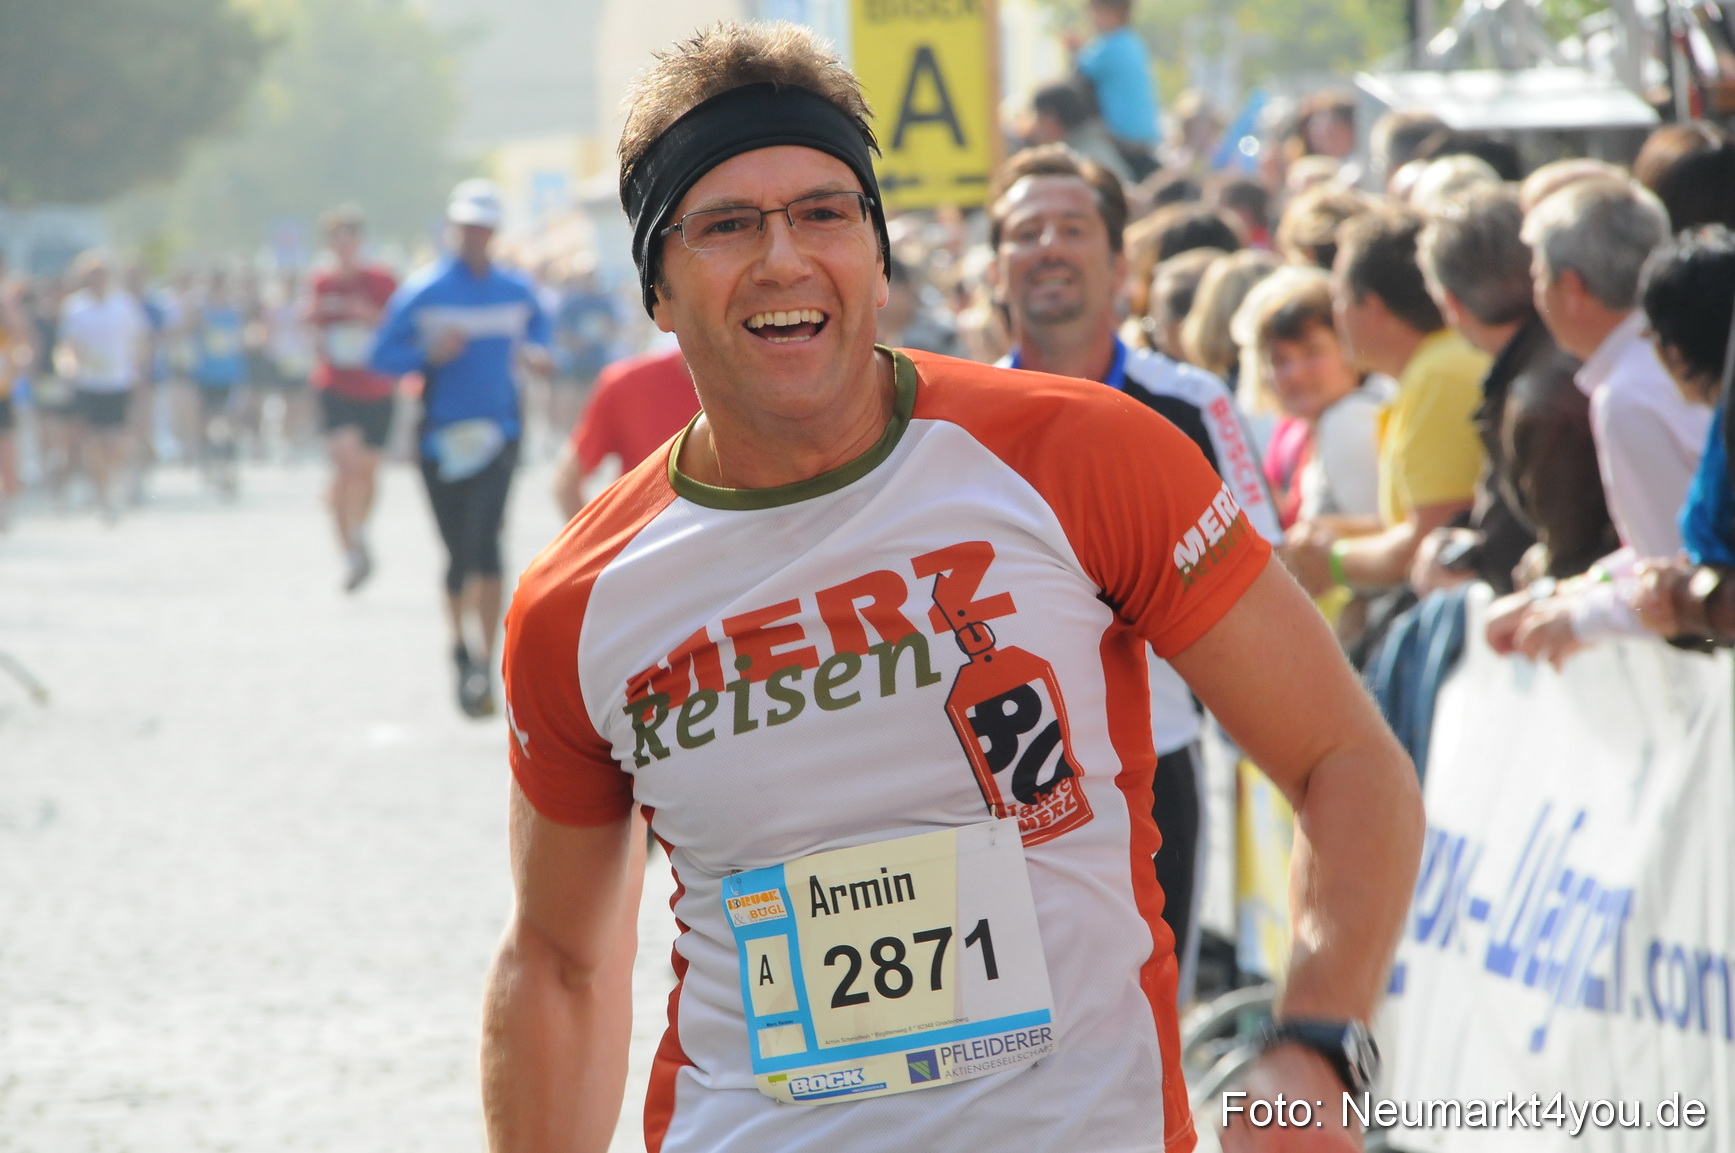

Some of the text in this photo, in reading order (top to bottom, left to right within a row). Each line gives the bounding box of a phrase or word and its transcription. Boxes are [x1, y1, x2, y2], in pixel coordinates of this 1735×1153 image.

[889, 44, 969, 149] A
[1208, 396, 1264, 507] BOSCH
[625, 540, 1018, 722] MERZ
[622, 631, 942, 769] Reisen
[749, 905, 785, 920] BÖGL
[809, 867, 916, 918] Armin
[759, 954, 775, 987] A
[824, 918, 999, 1009] 2871
[789, 1067, 865, 1095] BOCK
[940, 1026, 1053, 1066] PFLEIDERER
